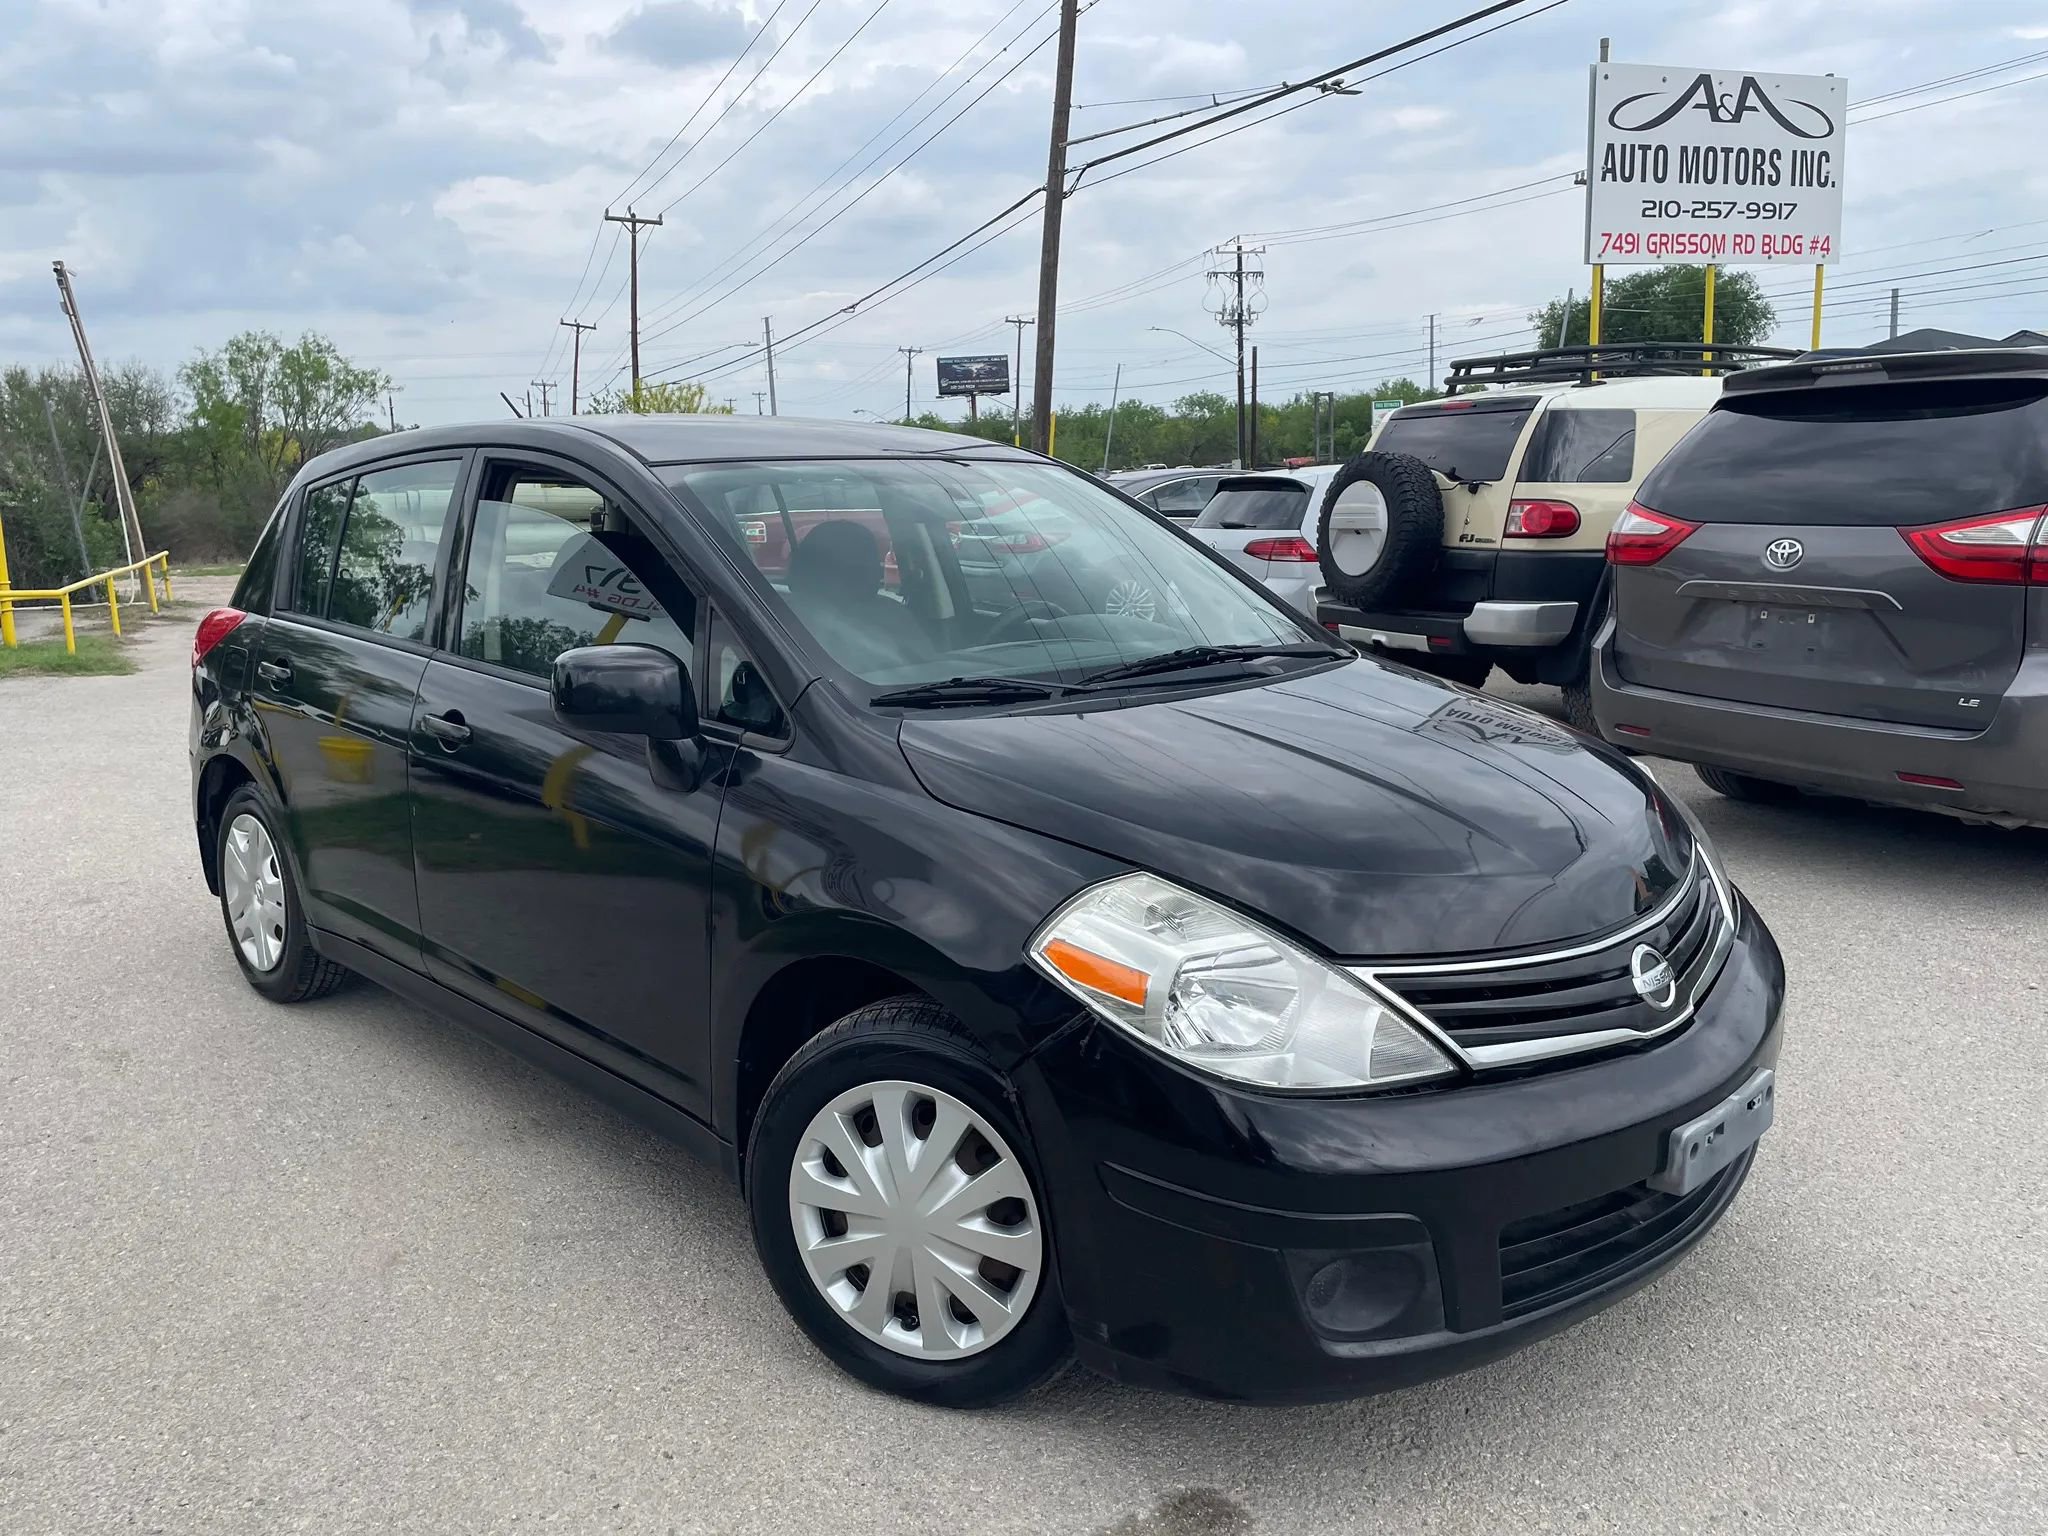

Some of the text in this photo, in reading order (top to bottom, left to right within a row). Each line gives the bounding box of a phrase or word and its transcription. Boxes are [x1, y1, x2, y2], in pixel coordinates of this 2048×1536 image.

[1601, 143, 1836, 188] AUTO MOTORS INC.
[1641, 200, 1798, 220] 210-257-9917
[1600, 232, 1831, 255] 7491 GRISSOM RD BLDG #4
[1459, 534, 1475, 543] FJ
[1958, 698, 1980, 708] LE
